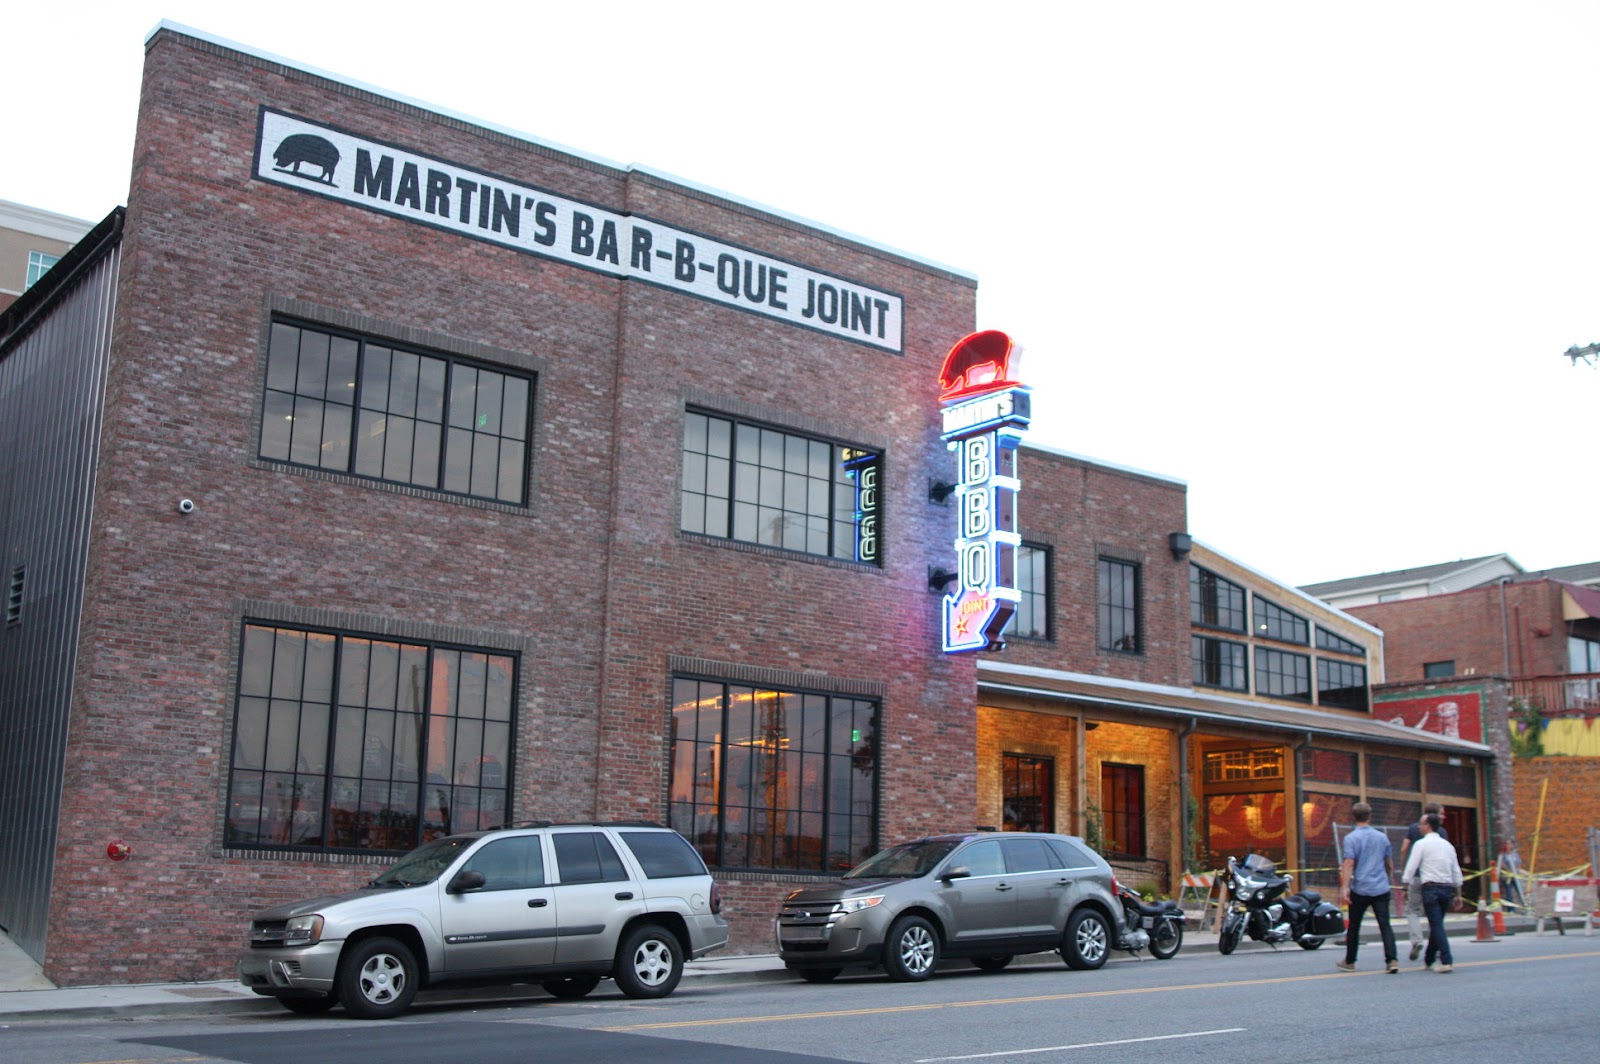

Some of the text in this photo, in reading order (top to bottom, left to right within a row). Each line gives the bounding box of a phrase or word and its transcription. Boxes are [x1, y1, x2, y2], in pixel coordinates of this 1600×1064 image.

[353, 147, 557, 247] MARTIN'S
[801, 277, 890, 339] JOINT
[963, 434, 990, 596] BBQ
[959, 598, 988, 615] JOINT
